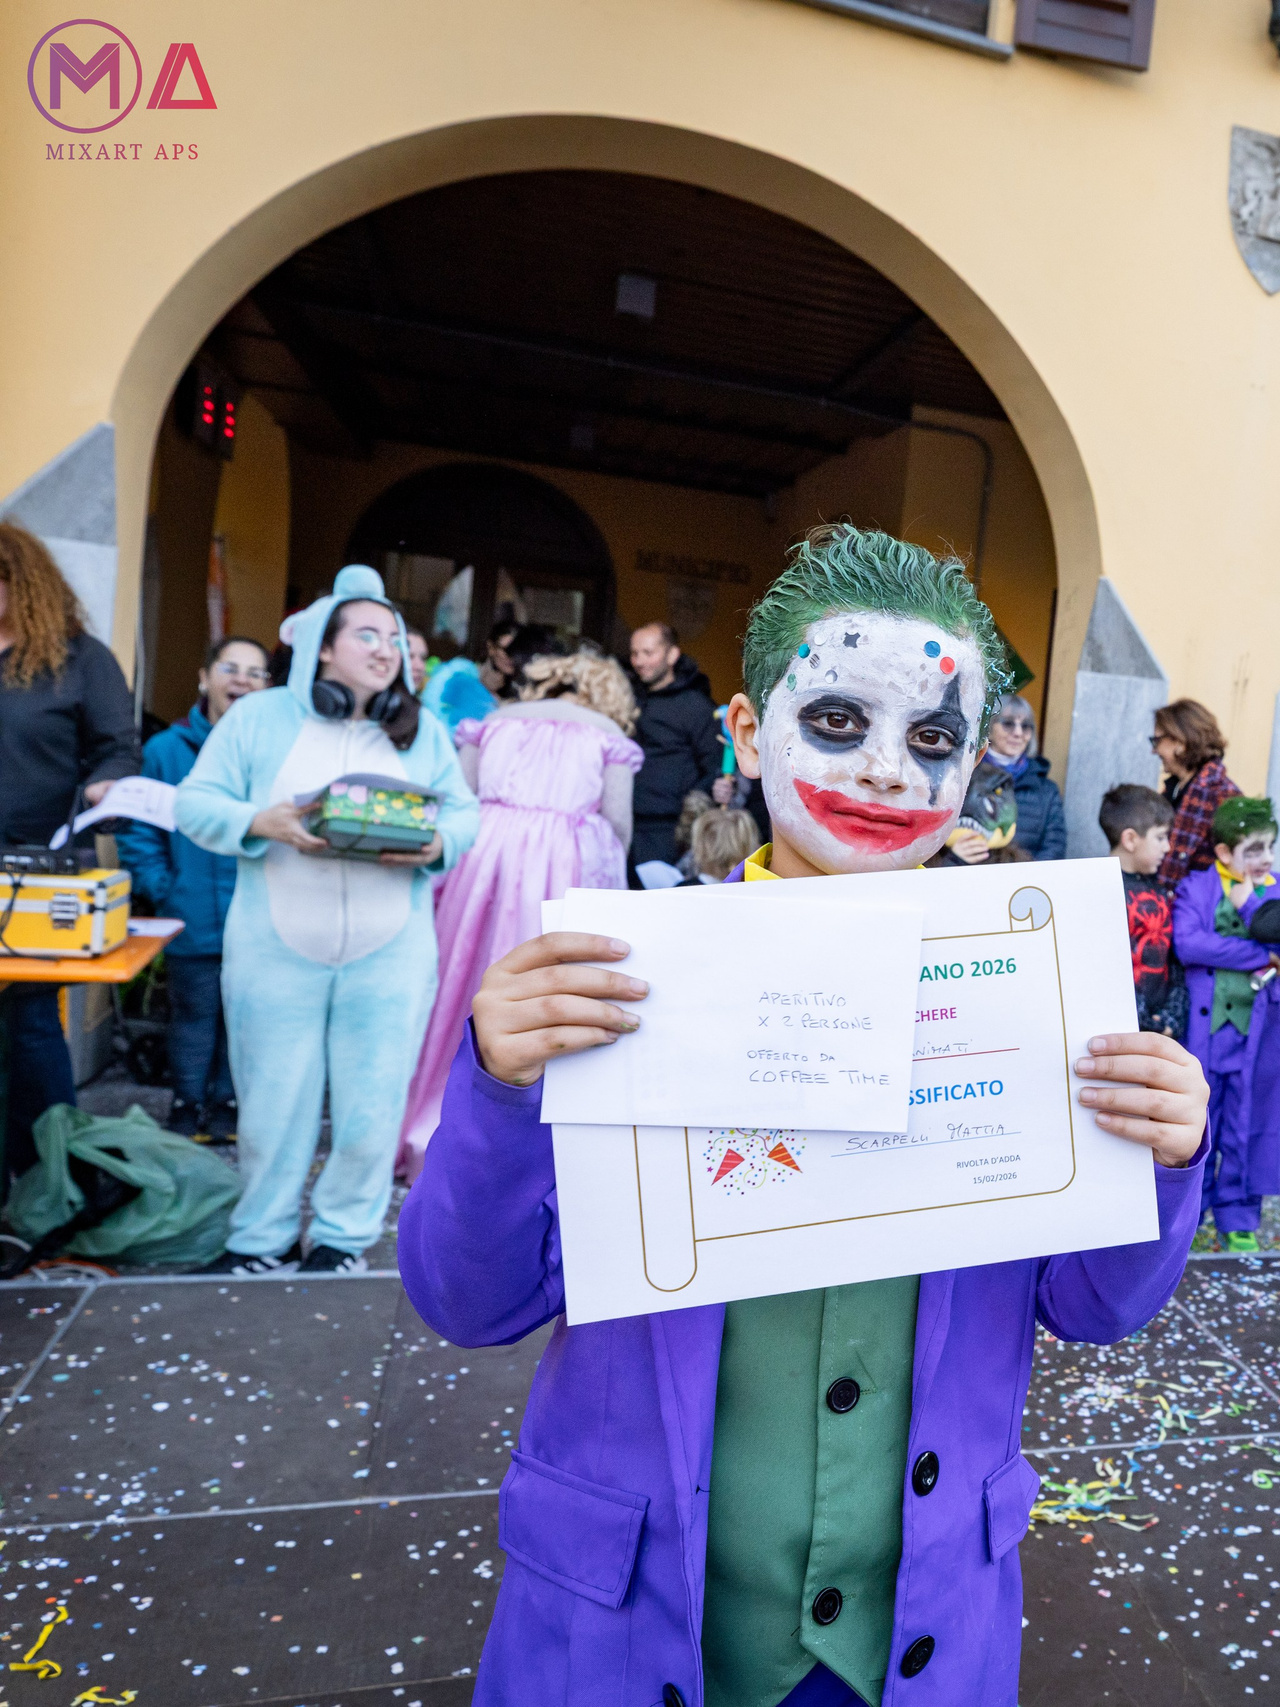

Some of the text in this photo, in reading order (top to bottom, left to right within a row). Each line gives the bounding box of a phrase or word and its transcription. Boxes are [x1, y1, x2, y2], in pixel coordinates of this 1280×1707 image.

[970, 957, 1017, 977] 2026
[758, 991, 847, 1008] APERITIVO
[758, 1012, 873, 1031] X 2 PERSONE
[746, 1049, 836, 1063] OFFERTO DA
[912, 1038, 973, 1057] NIMATI
[749, 1069, 890, 1086] COFFEE TIME
[946, 1122, 1005, 1140] MATTIA
[956, 1153, 1022, 1170] RIVOLTA D'ADDA
[972, 1171, 1018, 1185] 15/02/2026
